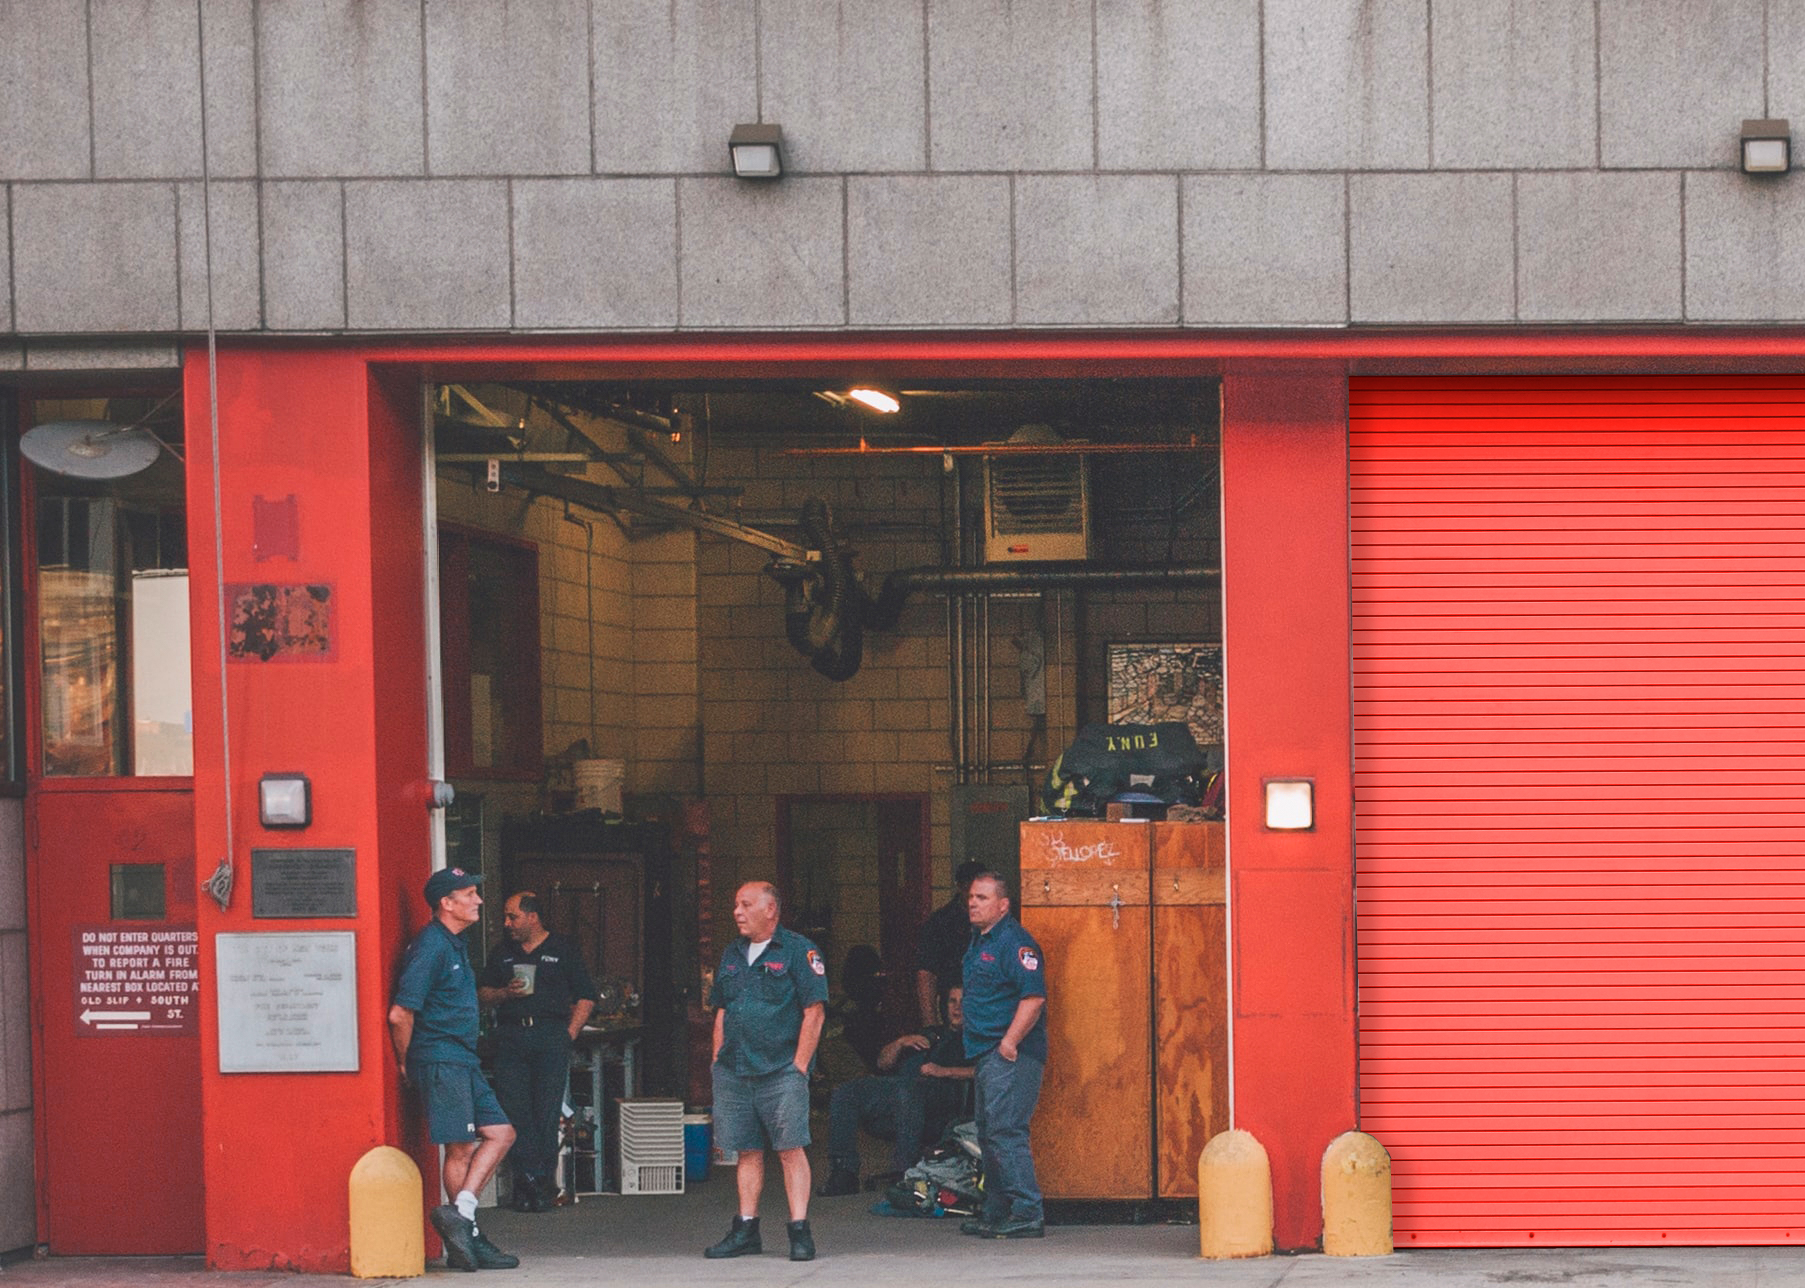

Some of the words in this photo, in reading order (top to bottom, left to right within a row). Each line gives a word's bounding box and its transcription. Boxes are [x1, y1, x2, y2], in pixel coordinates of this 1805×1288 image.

[82, 932, 96, 943] DO
[98, 932, 118, 943] NOT
[120, 932, 149, 942] ENTER
[151, 931, 199, 942] QUARTERS
[82, 945, 110, 956] WHEN
[112, 945, 161, 956] COMPANY
[164, 945, 175, 955] IS
[92, 958, 106, 968] TO
[109, 958, 149, 968] REPORT
[151, 958, 161, 968] A
[165, 957, 190, 968] FIRE
[85, 970, 113, 981] TURN
[116, 970, 127, 980] IN
[129, 970, 165, 980] ALARM
[169, 969, 198, 980] FROM
[80, 983, 122, 993] NEAREST
[124, 983, 144, 993] BOX
[146, 982, 189, 993] LOCATED
[81, 996, 102, 1005] OLD
[106, 996, 130, 1005] SLIP
[150, 995, 189, 1005] SOUTH
[167, 1008, 184, 1019] ST.
